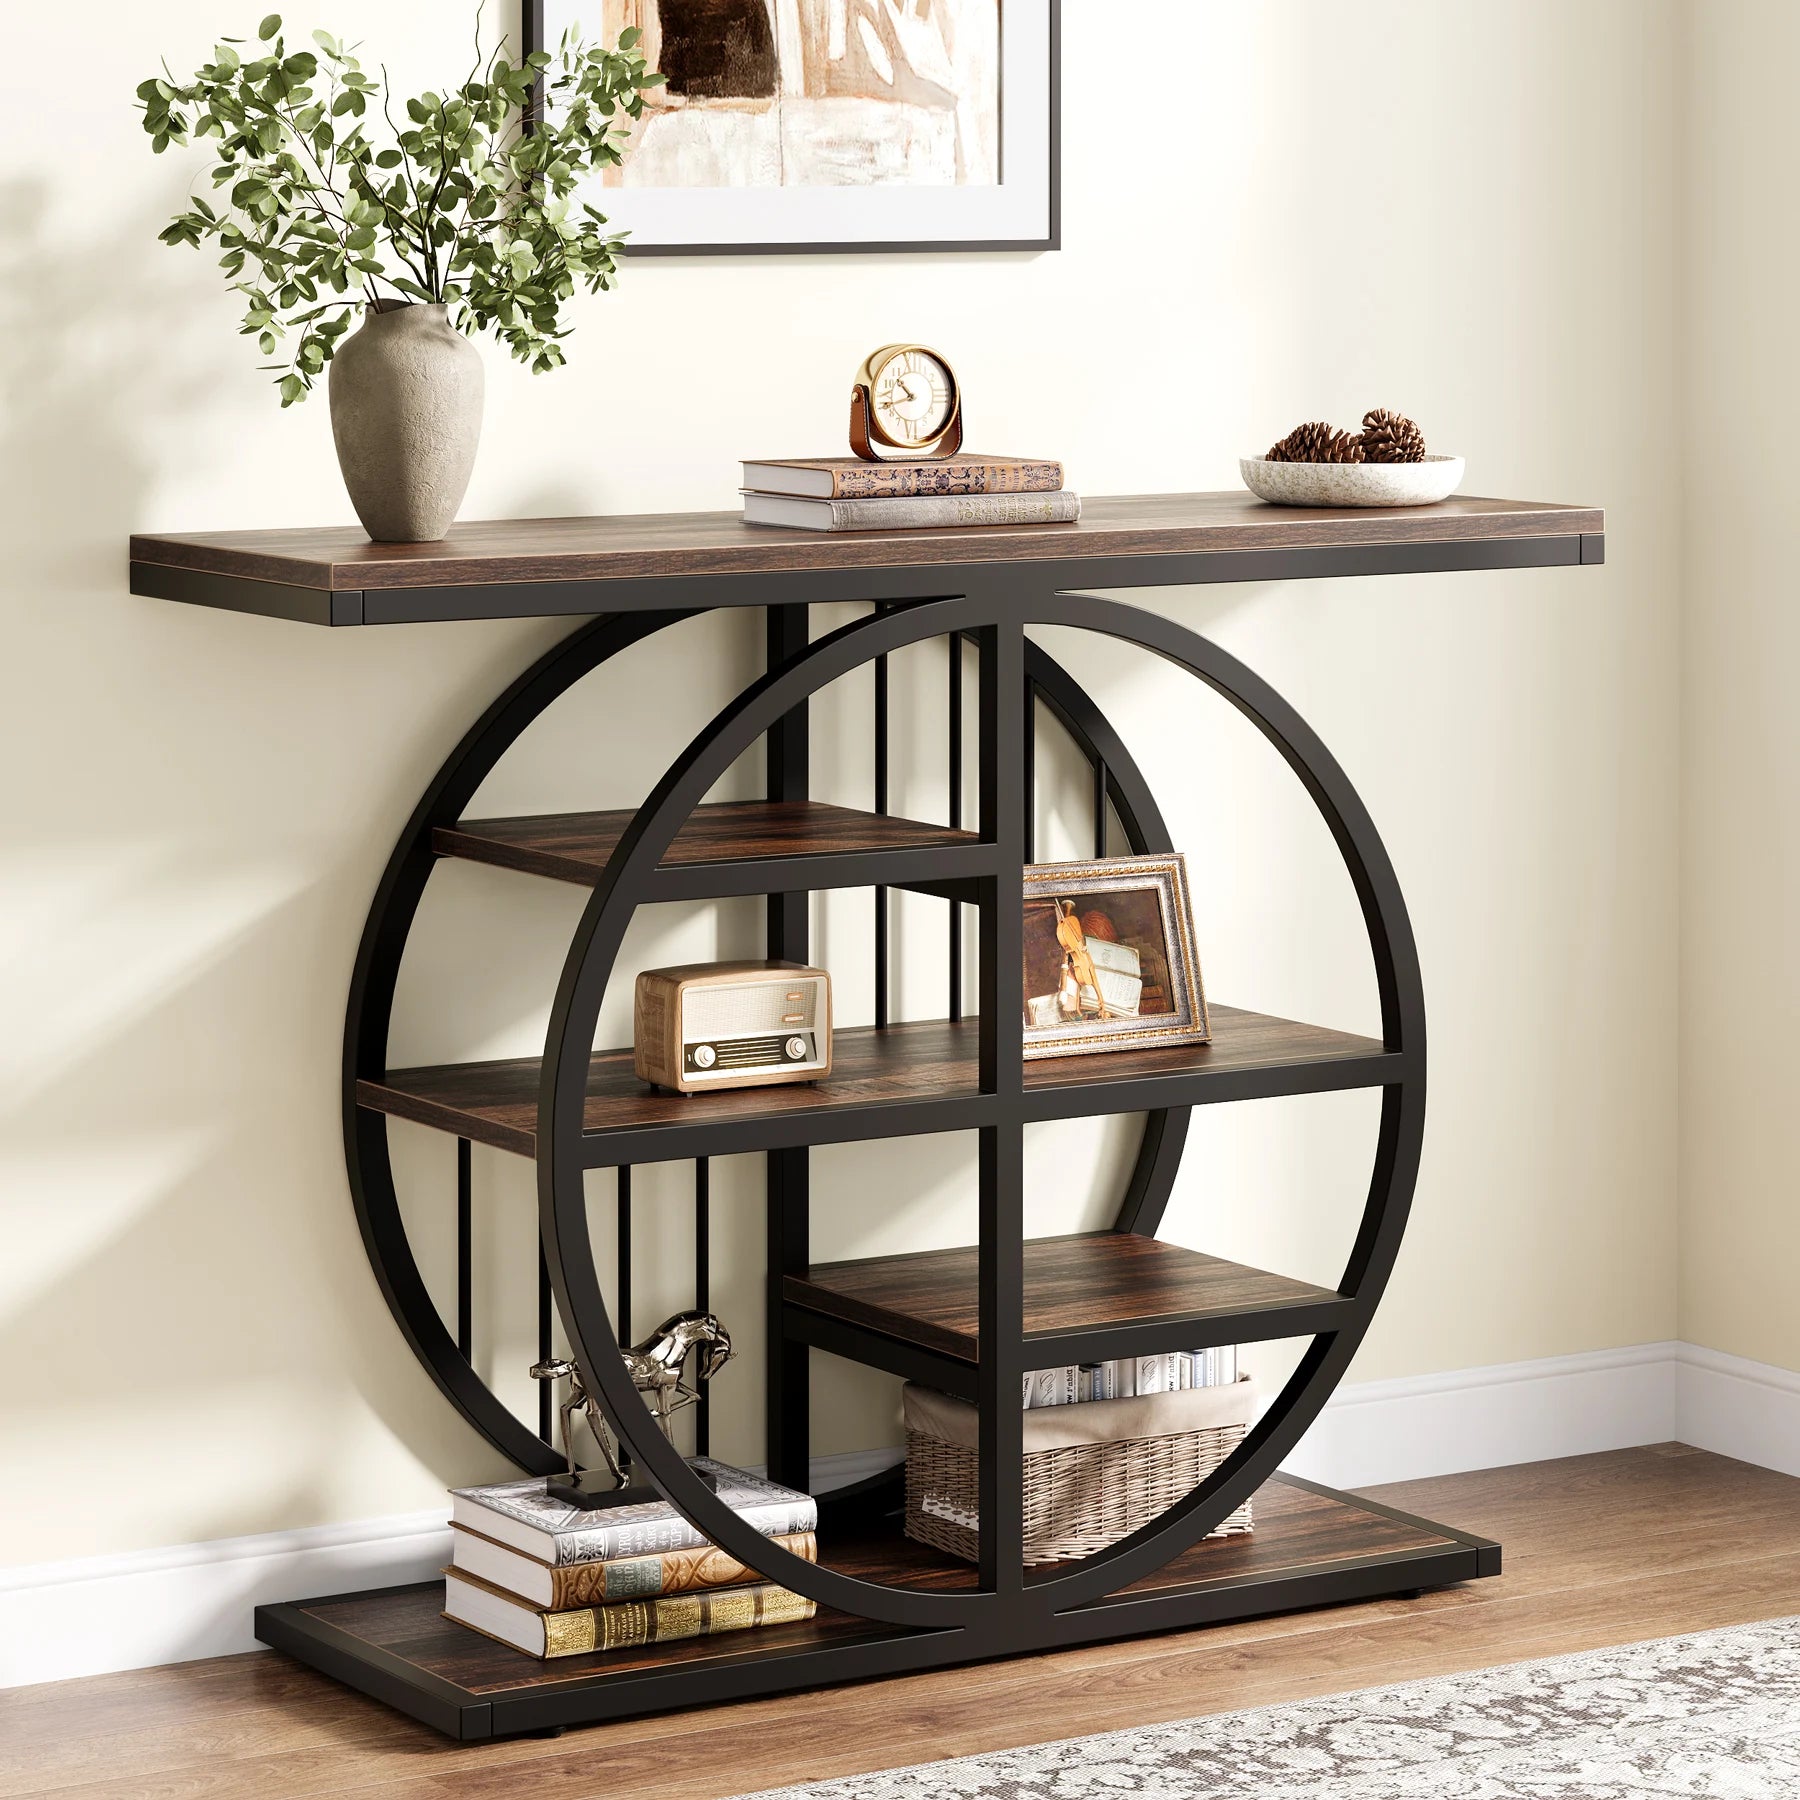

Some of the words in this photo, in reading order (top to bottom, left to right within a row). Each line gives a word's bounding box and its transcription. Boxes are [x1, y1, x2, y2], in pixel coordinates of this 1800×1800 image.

[892, 368, 901, 376] 11
[929, 373, 935, 382] 2
[884, 379, 894, 388] 10
[895, 418, 901, 426] 7
